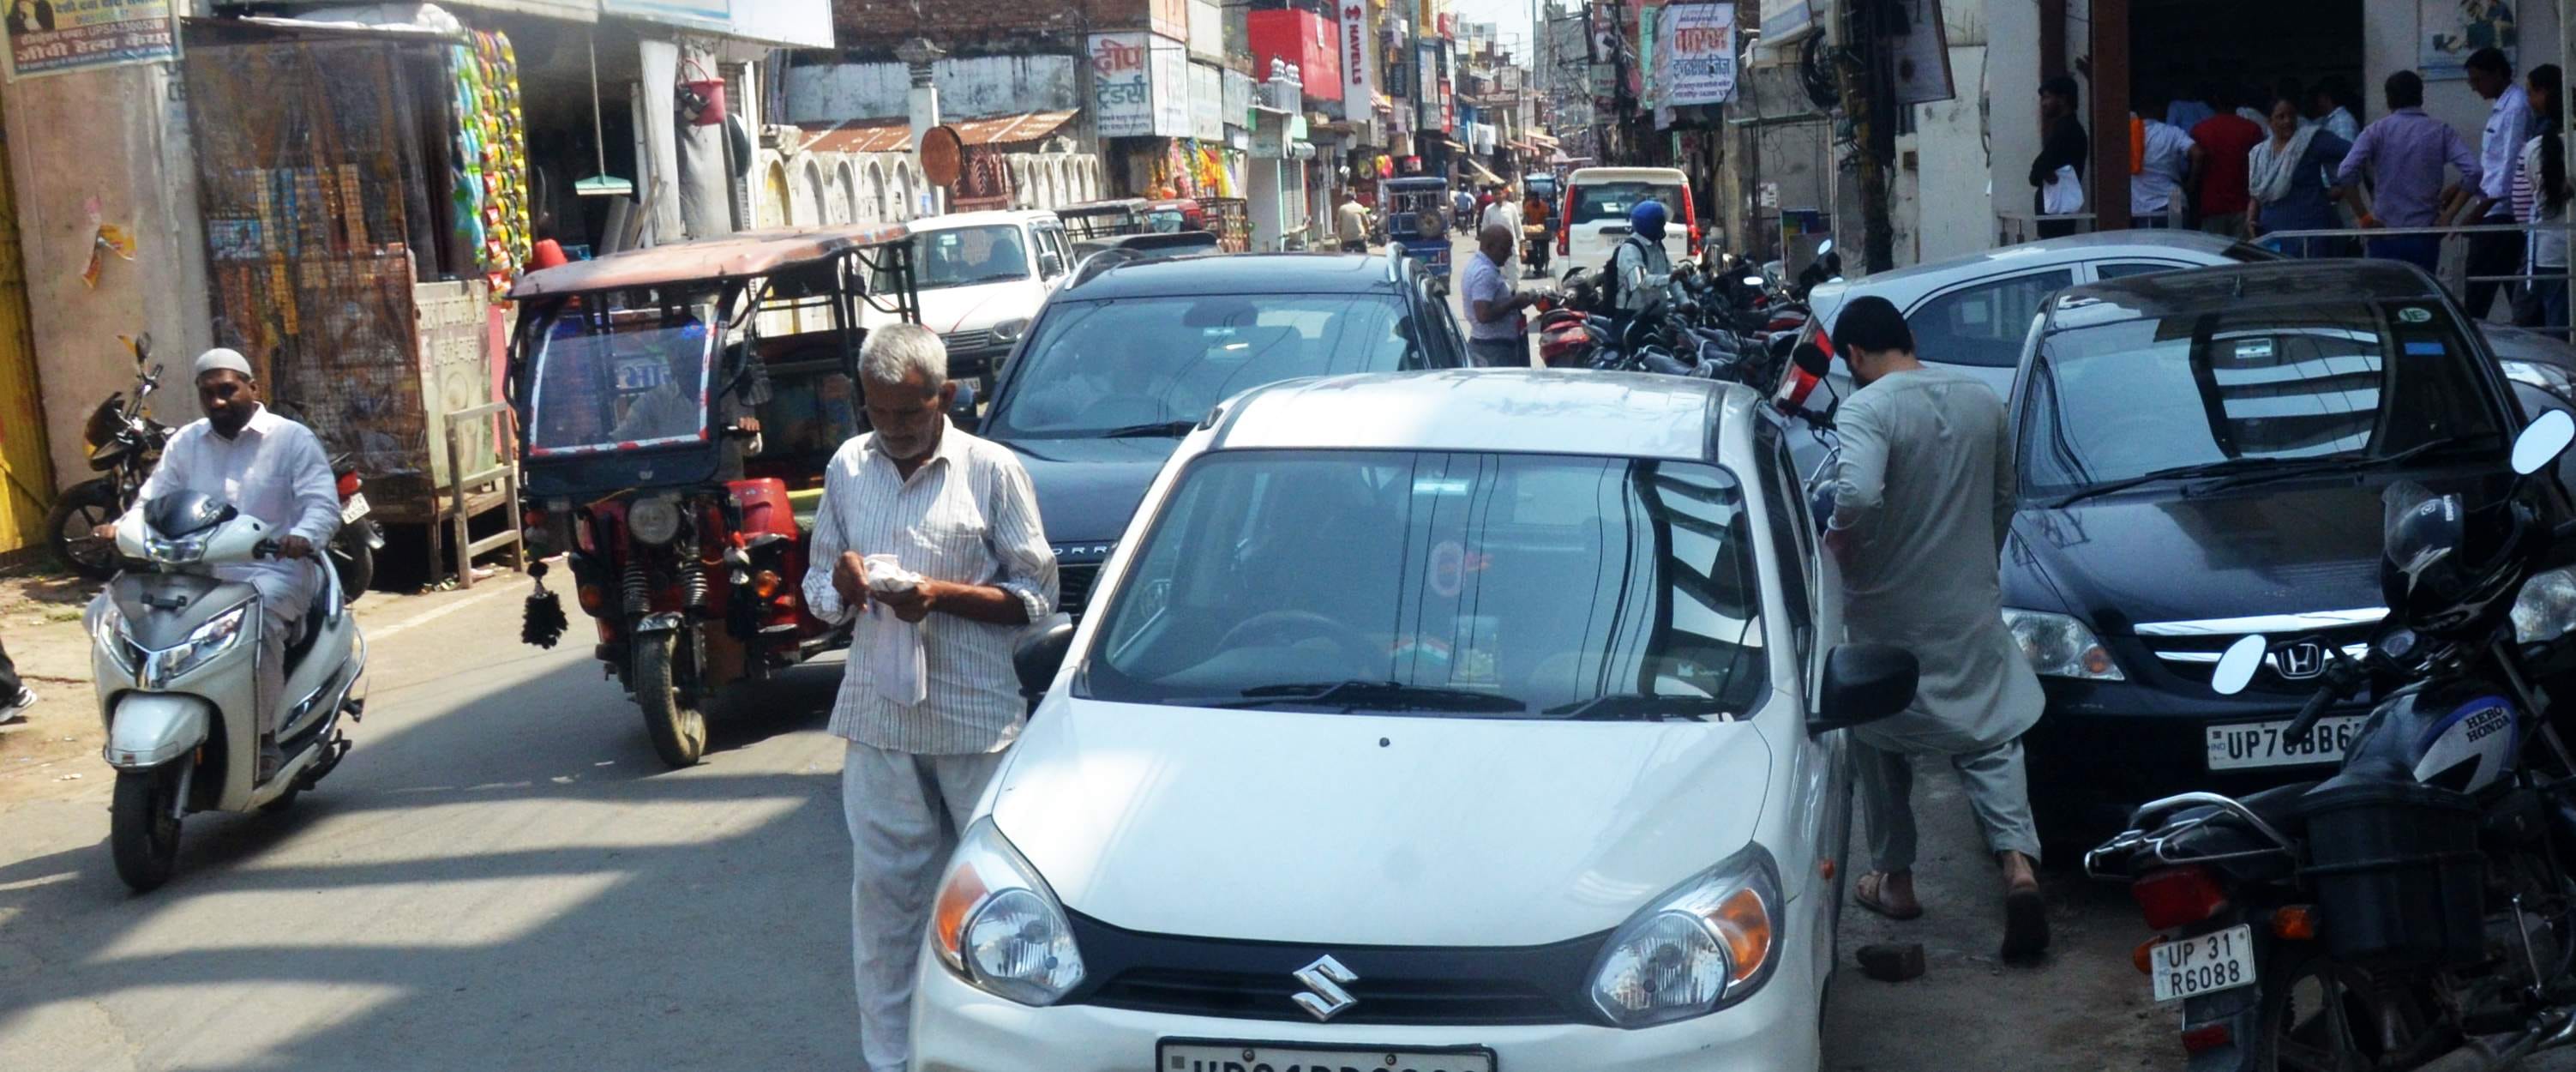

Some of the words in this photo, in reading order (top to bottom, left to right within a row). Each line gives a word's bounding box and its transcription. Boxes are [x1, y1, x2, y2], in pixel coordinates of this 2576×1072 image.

[1093, 39, 1144, 77] दीप
[1348, 24, 1362, 85] HAVELLS
[1096, 74, 1147, 110] ट्रेडर्स
[2465, 705, 2503, 729] HERO
[2466, 715, 2510, 743] HONDA
[2168, 942, 2195, 967] UP
[2207, 932, 2231, 960] 31
[2171, 960, 2240, 996] R6088
